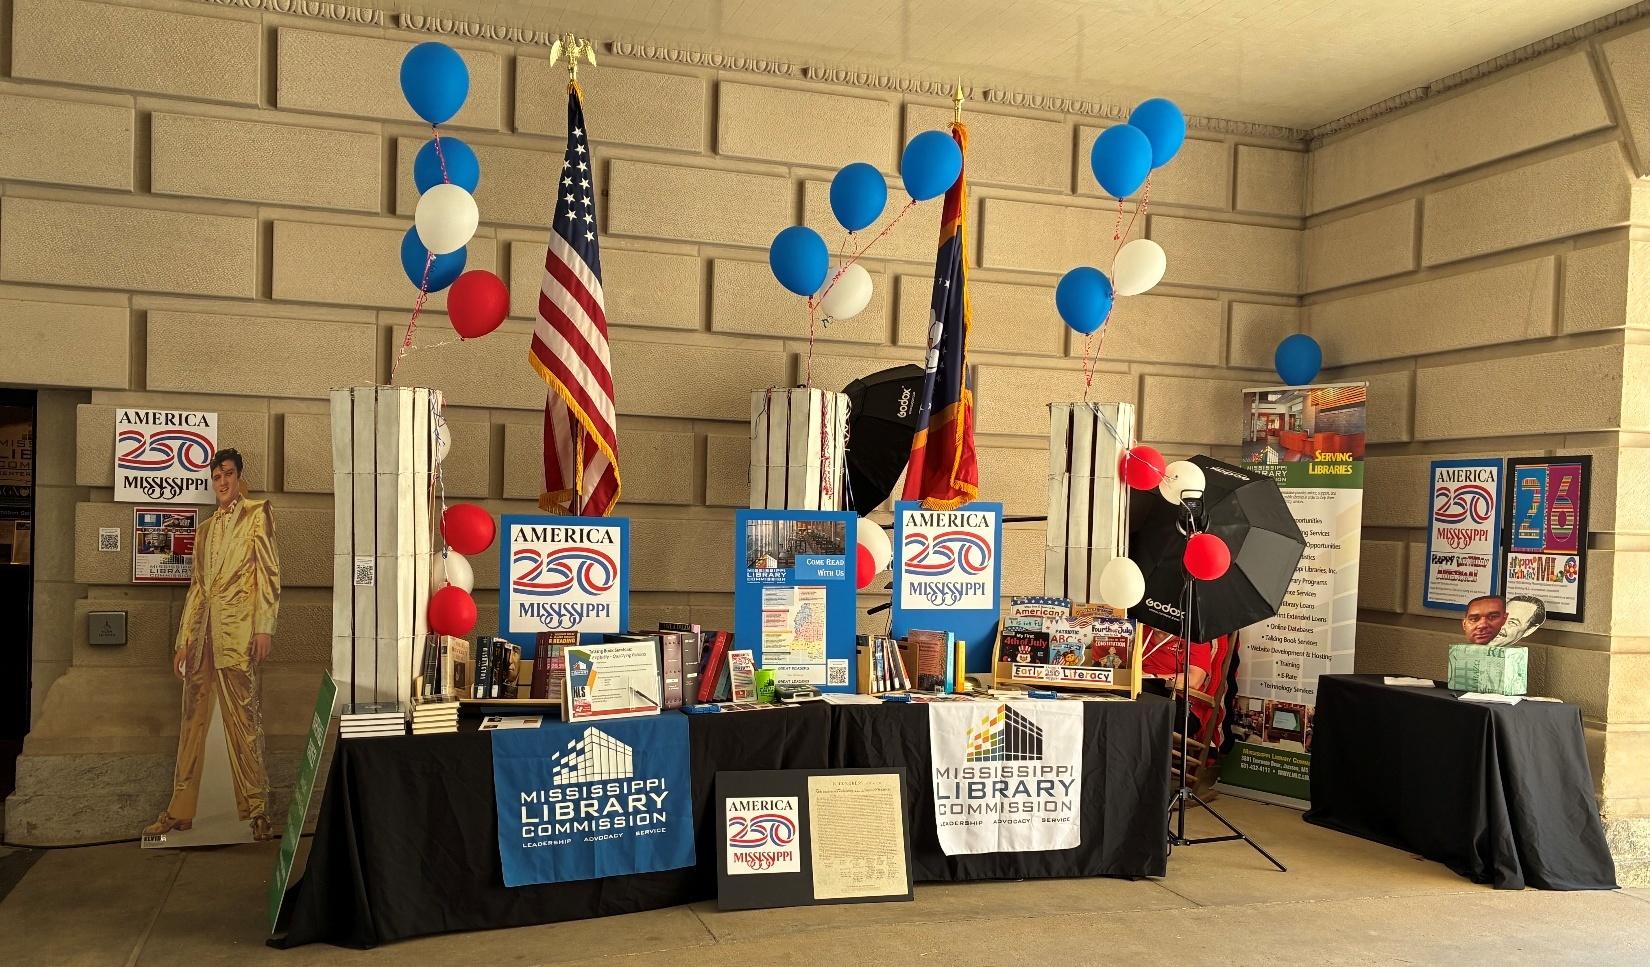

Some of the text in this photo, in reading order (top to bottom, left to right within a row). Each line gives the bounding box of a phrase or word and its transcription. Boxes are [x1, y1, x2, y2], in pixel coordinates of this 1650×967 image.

[897, 388, 911, 418] Godox
[119, 411, 210, 428] AMERICA
[118, 429, 215, 473] 250
[1315, 450, 1353, 462] SERVING
[1309, 463, 1353, 475] LIBRARIES
[1437, 469, 1496, 483] AMERICA
[123, 475, 208, 499] MISSISSIPPI
[1435, 484, 1495, 524] 250
[905, 513, 990, 528] AMERICA
[514, 526, 615, 544] AMERICA
[1306, 541, 1341, 550] Opportunities
[1436, 527, 1489, 550] MISSISSIPPI
[905, 531, 992, 576] 250
[513, 547, 618, 596] 250
[1302, 578, 1328, 586] Programs
[909, 581, 986, 606] MISSISSIPPI
[519, 602, 610, 629] MISSISSIPPI
[1015, 606, 1065, 616] American?
[1145, 597, 1187, 620] Godox
[1091, 624, 1110, 633] Fourth
[1015, 666, 1042, 677] Early
[1063, 669, 1110, 683] Literacy
[936, 765, 1074, 780] MISSISSIPPI
[521, 777, 666, 804] MISSISSIPPI
[936, 778, 1076, 800] LIBRARY
[521, 790, 669, 824] LIBRARY
[729, 799, 793, 812] AMERICA
[938, 799, 1072, 815] COMMISSION
[522, 811, 667, 838] COMMISSION
[728, 813, 796, 848] 250
[522, 827, 667, 848] LEADERSHIP ADVOCACY SERVICE
[733, 851, 793, 870] MISSISSIPPI
